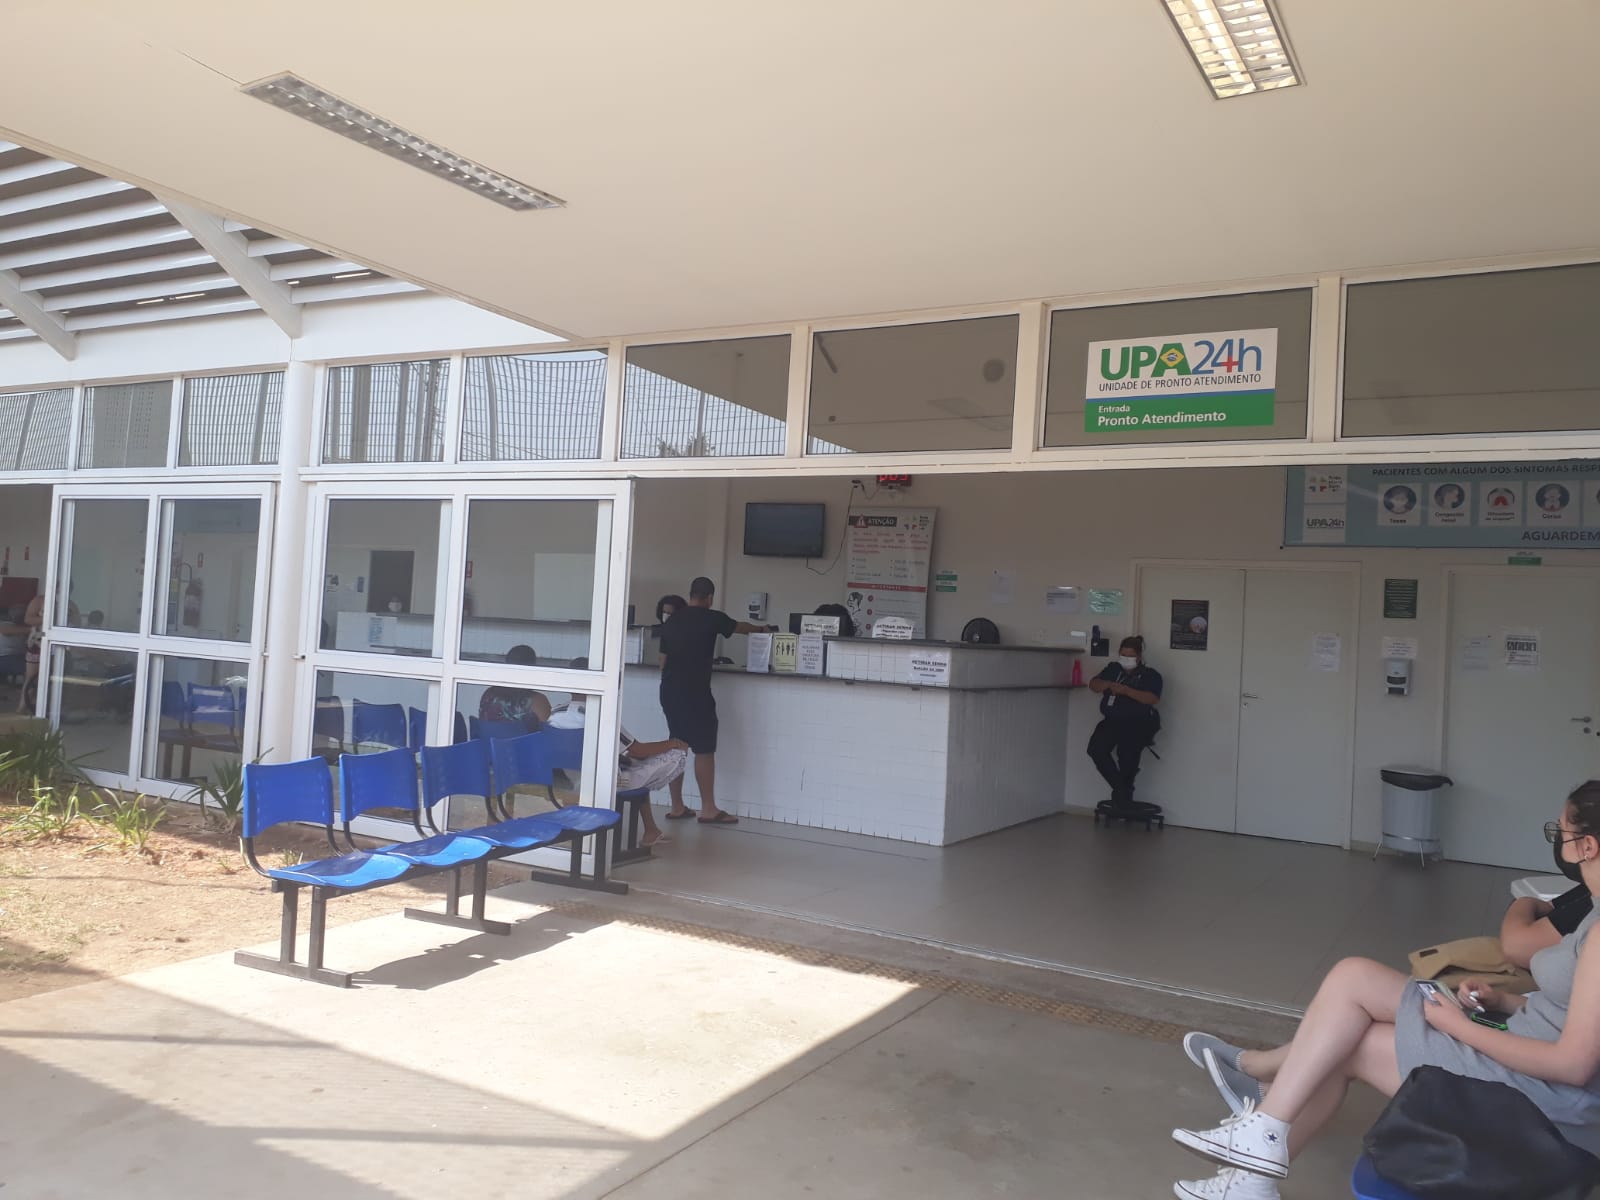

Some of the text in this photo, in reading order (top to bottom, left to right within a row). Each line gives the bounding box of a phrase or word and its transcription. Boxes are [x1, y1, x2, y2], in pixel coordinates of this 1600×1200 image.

[1099, 373, 1262, 392] UNIDADE DE PRONTO ATENDIMENTO
[1098, 404, 1131, 413] Entrada
[1098, 411, 1227, 427] Pronto Atendimento
[1372, 467, 1421, 476] PACIENTES
[1424, 466, 1448, 475] COM
[1450, 466, 1488, 475] ALGUM
[1490, 465, 1512, 474] DOS
[1514, 464, 1569, 473] SINTOMAS
